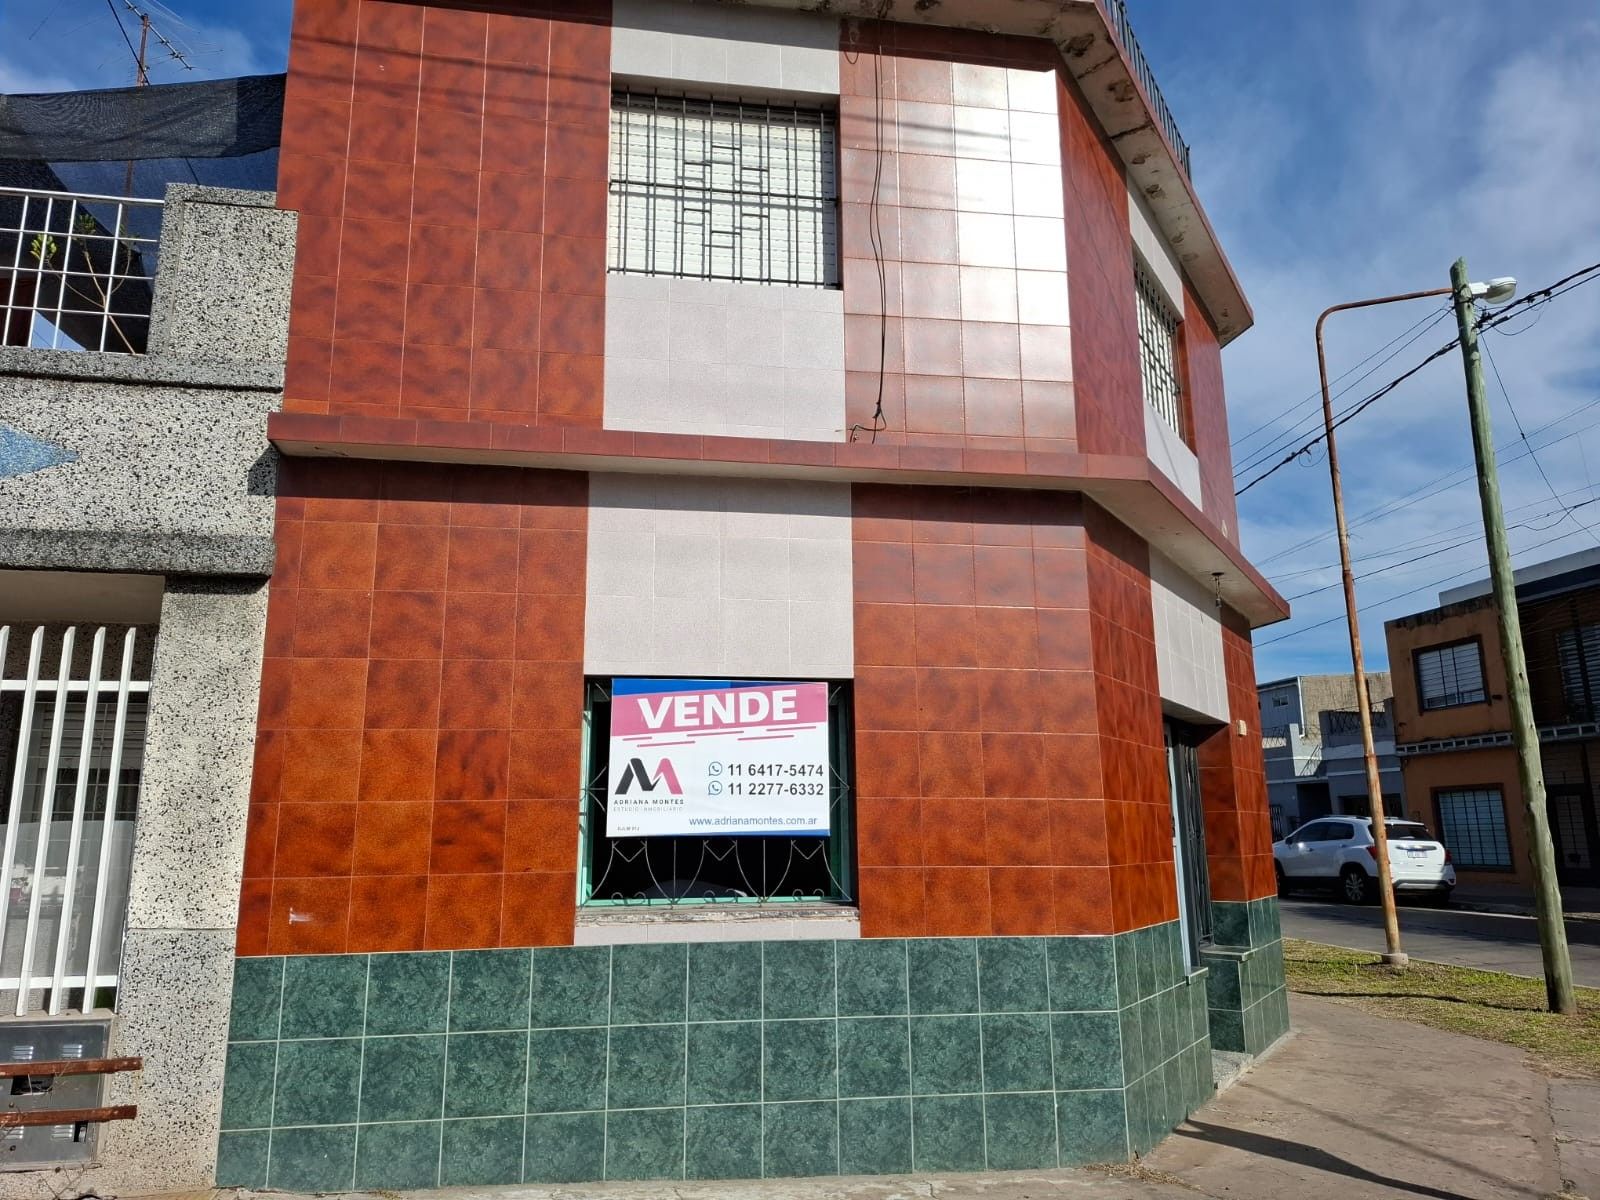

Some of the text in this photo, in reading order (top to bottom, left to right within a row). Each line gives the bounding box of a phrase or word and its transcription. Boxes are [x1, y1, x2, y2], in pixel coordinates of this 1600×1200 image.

[637, 689, 798, 729] VENDE
[728, 763, 824, 777] 11 6417-5474
[728, 782, 824, 796] 11 2277-6332
[689, 816, 818, 826] www.adrianamontes.com.ar
